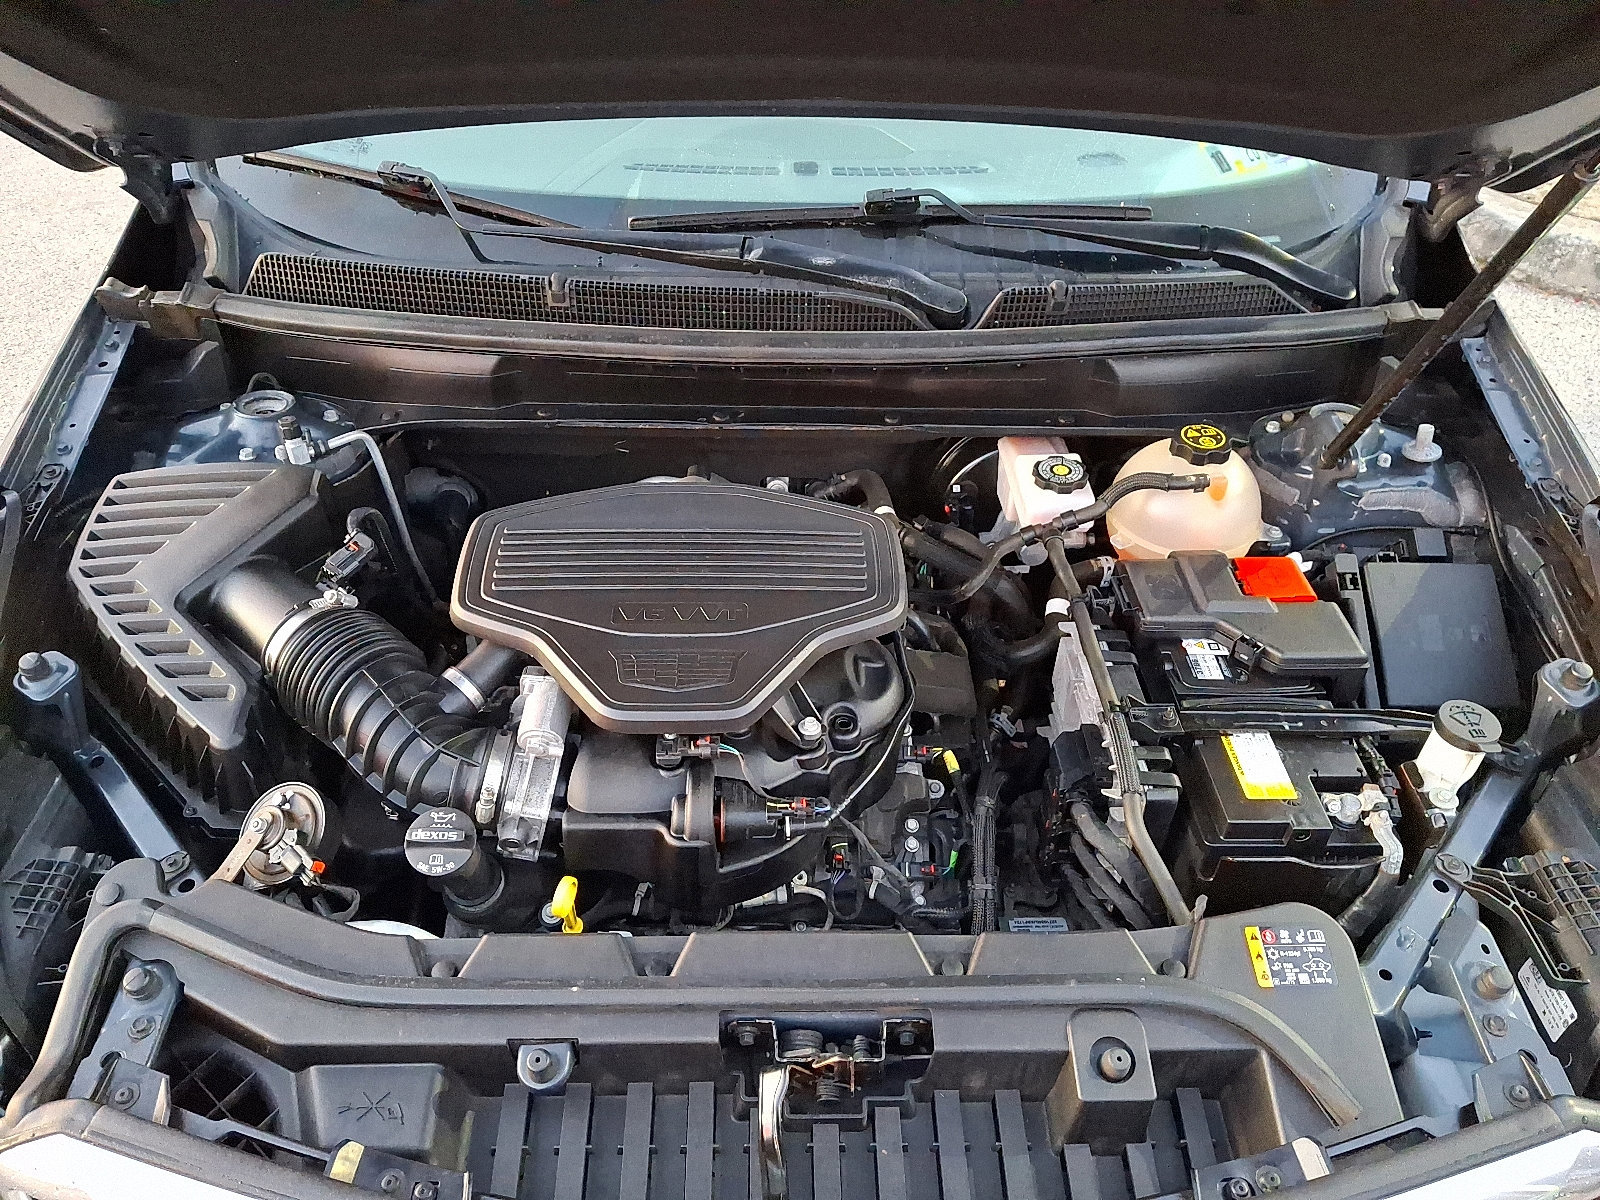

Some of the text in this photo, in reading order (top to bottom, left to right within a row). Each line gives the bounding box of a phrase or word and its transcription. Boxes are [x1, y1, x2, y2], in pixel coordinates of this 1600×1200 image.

[618, 606, 744, 621] V6 VVT
[411, 828, 458, 840] dexos
[416, 861, 456, 874] SAE 5W-30
